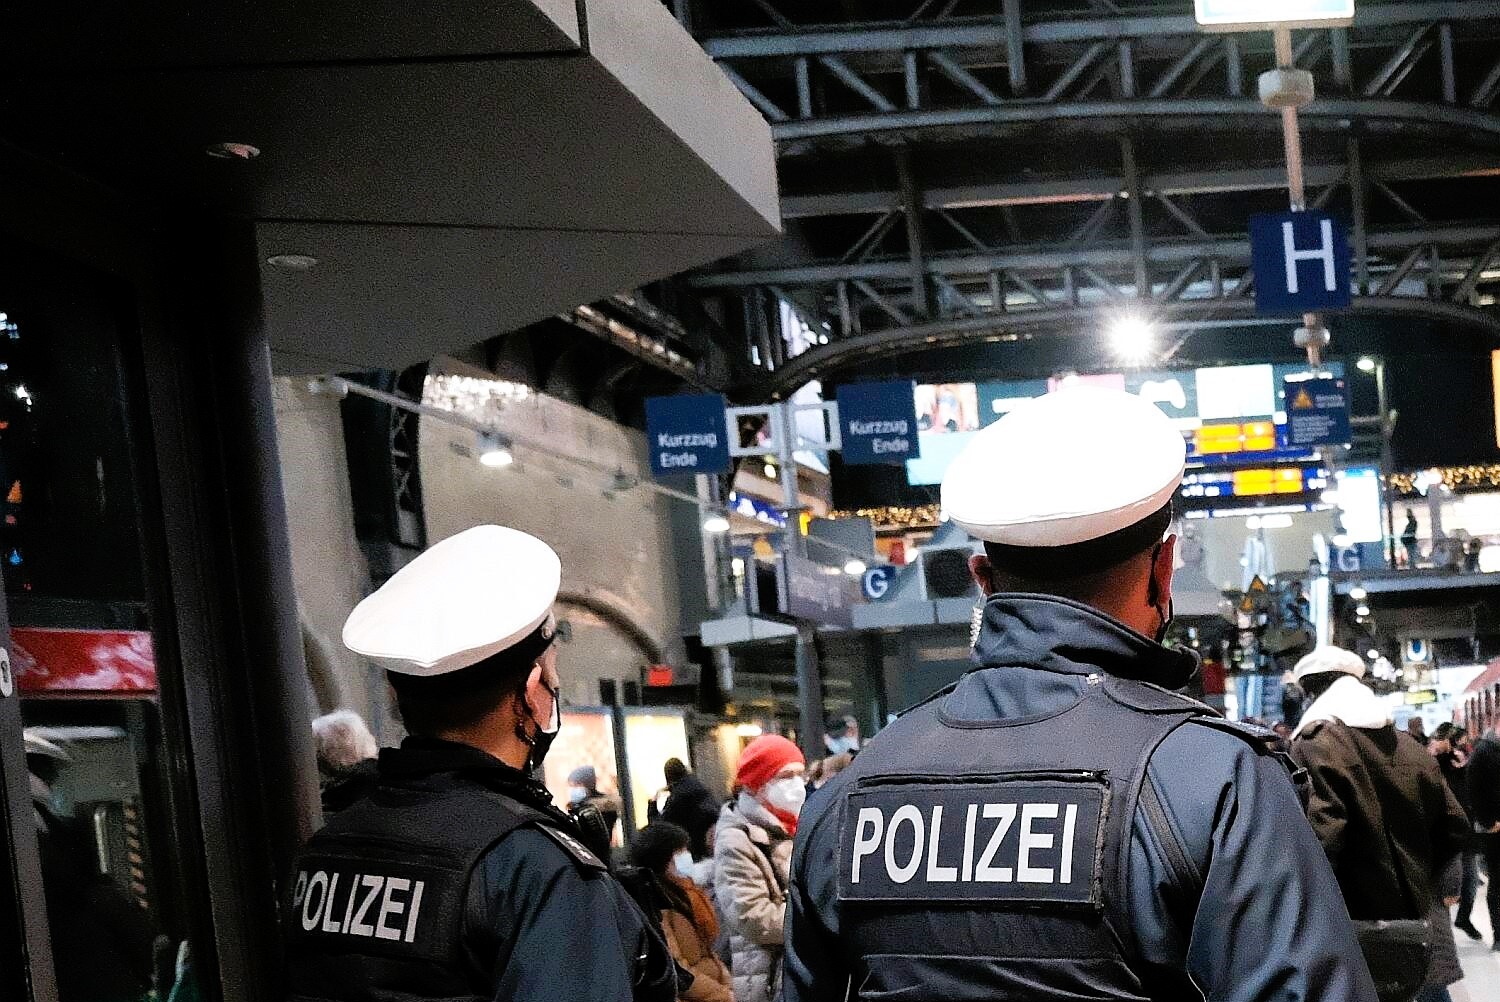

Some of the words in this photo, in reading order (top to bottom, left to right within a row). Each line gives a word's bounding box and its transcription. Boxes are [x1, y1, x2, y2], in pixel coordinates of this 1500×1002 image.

[1282, 218, 1336, 294] H
[849, 419, 909, 436] Kurzzug
[657, 432, 718, 448] Kurzzug
[871, 437, 910, 453] Ende
[660, 451, 698, 468] Ende
[865, 568, 889, 599] G
[851, 803, 1078, 884] POLIZEI
[293, 870, 426, 943] POLIZEI
